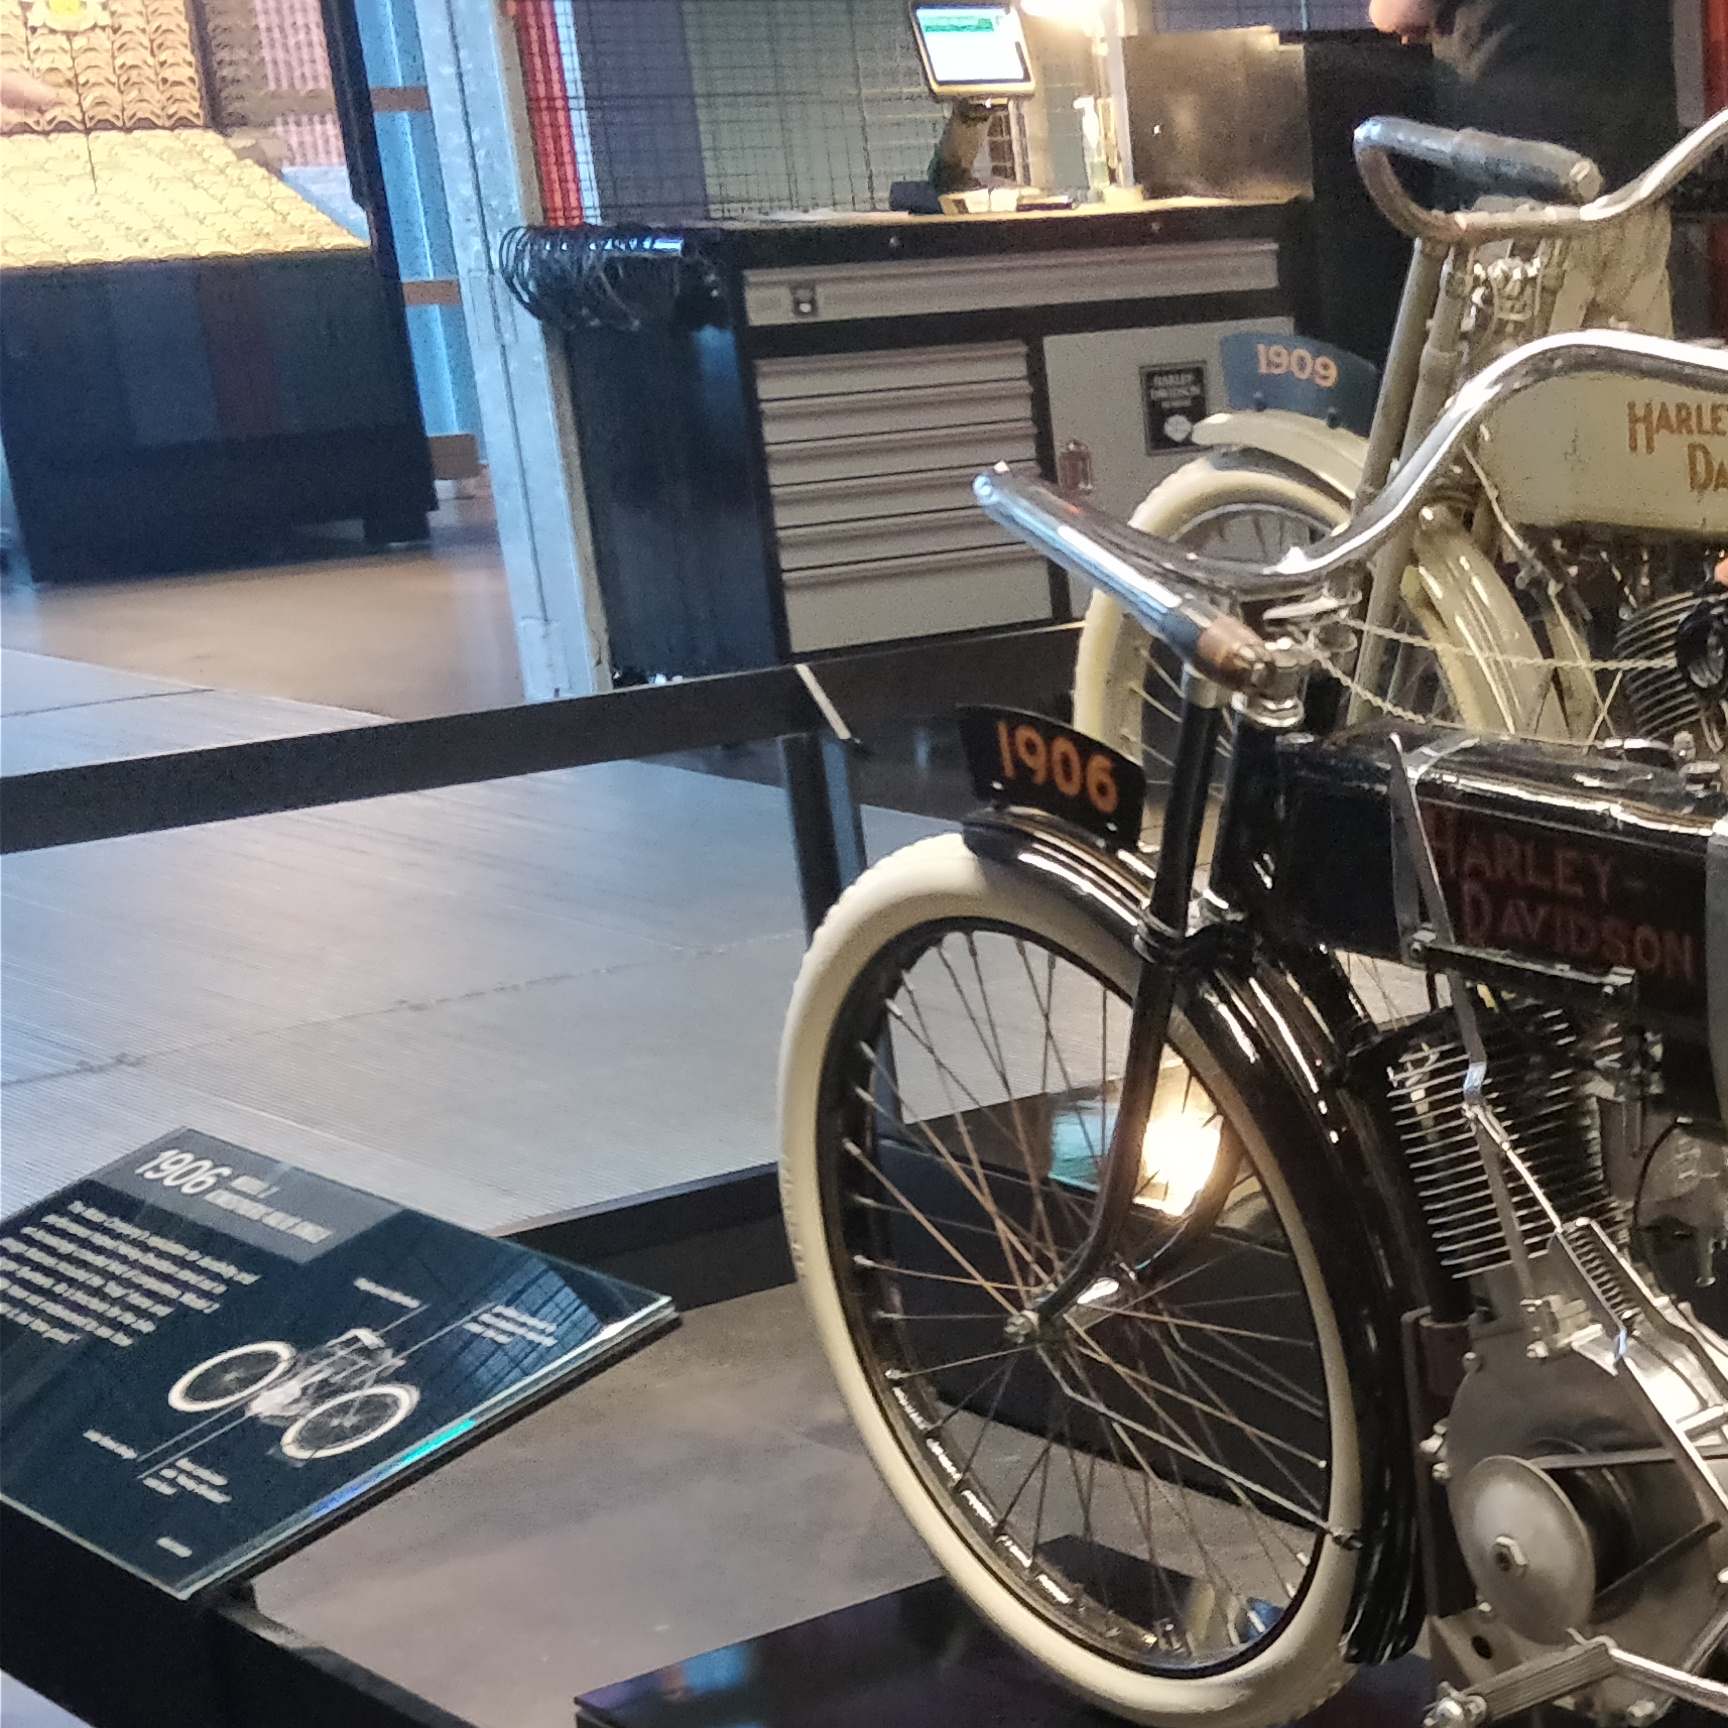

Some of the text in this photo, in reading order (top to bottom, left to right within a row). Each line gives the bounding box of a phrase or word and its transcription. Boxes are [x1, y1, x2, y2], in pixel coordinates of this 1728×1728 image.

[1256, 343, 1339, 389] 1909
[995, 720, 1120, 815] 1906
[1461, 880, 1697, 979] DAVIDSON
[134, 1149, 233, 1195] 1906
